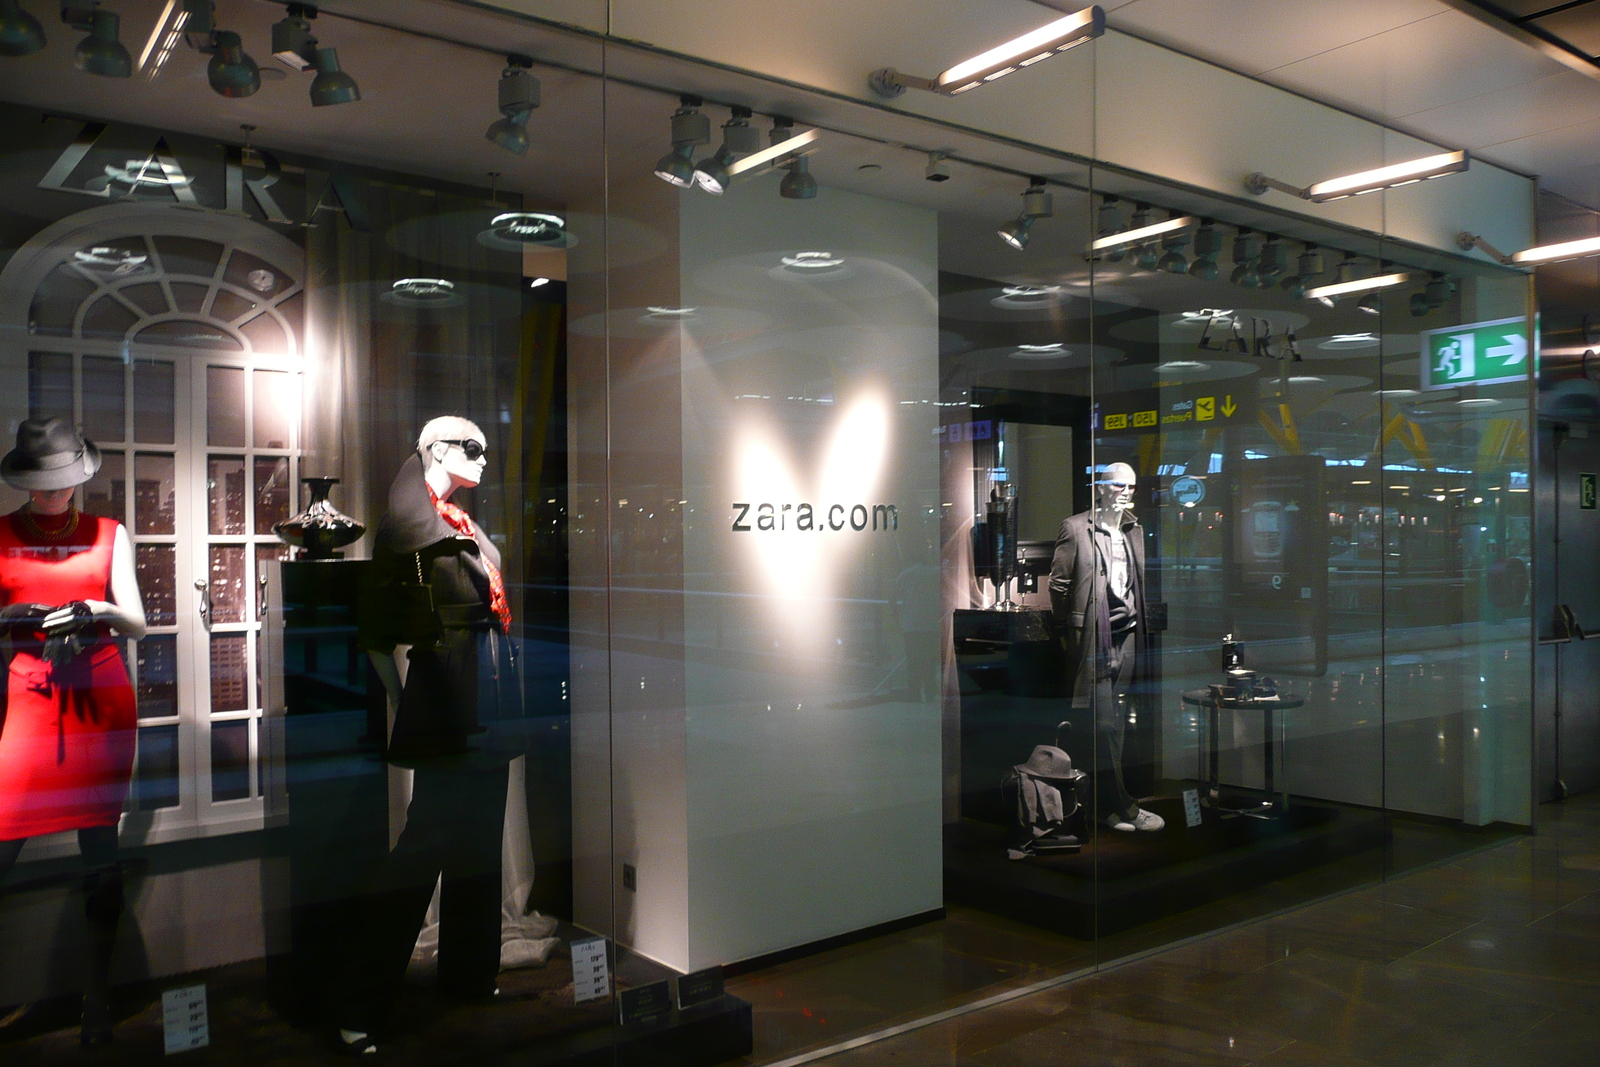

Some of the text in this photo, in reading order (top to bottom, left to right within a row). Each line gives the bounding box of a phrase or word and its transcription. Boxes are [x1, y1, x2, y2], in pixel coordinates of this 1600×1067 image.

[38, 112, 375, 233] ZARA
[1198, 308, 1302, 361] ZARA
[732, 503, 898, 532] zara.com
